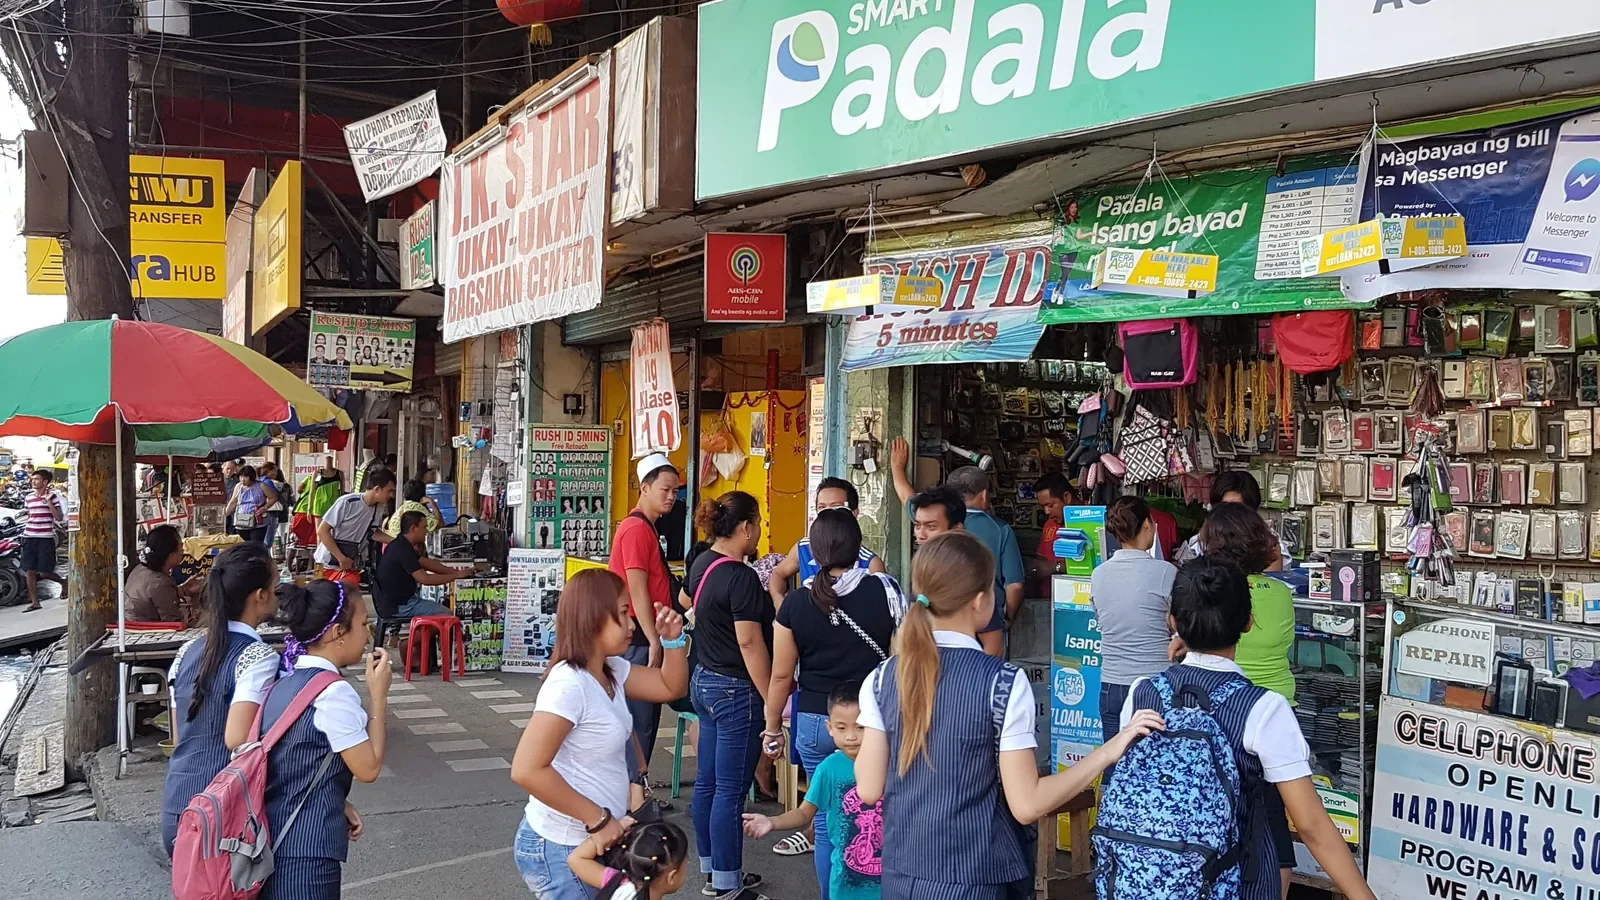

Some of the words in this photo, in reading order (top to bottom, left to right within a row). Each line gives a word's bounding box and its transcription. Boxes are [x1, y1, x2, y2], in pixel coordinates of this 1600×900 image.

[756, 0, 1170, 153] Padala
[349, 115, 392, 152] CELLPHONE
[505, 80, 601, 210] STAR
[1379, 140, 1477, 167] Magbayad
[1482, 137, 1510, 153] ng
[1515, 128, 1549, 148] bill
[1374, 174, 1395, 187] sa
[1401, 159, 1508, 186] Messenger
[1096, 192, 1164, 218] Padala
[130, 212, 202, 225] RANSFER
[1090, 222, 1157, 245] Isang
[1162, 203, 1248, 238] bayad
[1382, 222, 1401, 232] PERA
[1546, 212, 1584, 223] Welcome
[1586, 214, 1597, 223] to
[457, 180, 589, 280] UKAY-UKAY
[1383, 230, 1402, 243] AGAD
[1543, 226, 1590, 238] Messenger
[1108, 258, 1134, 270] AGAD
[1110, 251, 1134, 262] PERA
[1150, 254, 1169, 262] LOAN
[448, 263, 523, 324] BAGSAKAN
[527, 235, 595, 300] CENTER
[990, 246, 1052, 307] ID
[731, 295, 759, 304] mobile
[316, 316, 350, 326] RUSH
[354, 319, 368, 328] ID
[370, 320, 378, 329] 5
[380, 321, 411, 331] MINS
[876, 322, 894, 348] 5
[898, 318, 998, 345] minutes
[644, 358, 658, 391] ng
[640, 390, 673, 410] Klase
[534, 430, 561, 441] RUSH
[564, 430, 574, 441] ID
[577, 431, 606, 441] 5MINS
[642, 410, 674, 450] 10
[1078, 584, 1092, 593] LOA
[1065, 634, 1102, 654] Isang
[1082, 655, 1098, 666] na
[1406, 645, 1486, 669] REPAIR
[1056, 680, 1083, 696] AGAD
[1057, 670, 1082, 686] PERA
[1054, 710, 1083, 727] LOAN
[1083, 718, 1091, 727] TO
[1059, 728, 1088, 737] HASSLE-FREE
[1395, 711, 1595, 782] CELLPHONE
[1447, 763, 1600, 818] OPENLI
[1324, 796, 1346, 808] Smart
[1392, 792, 1530, 856] HARDWARE
[1542, 827, 1556, 864] &
[1400, 839, 1538, 895] PROGRAM
[1546, 879, 1565, 900] &
[1426, 873, 1468, 900] WE
